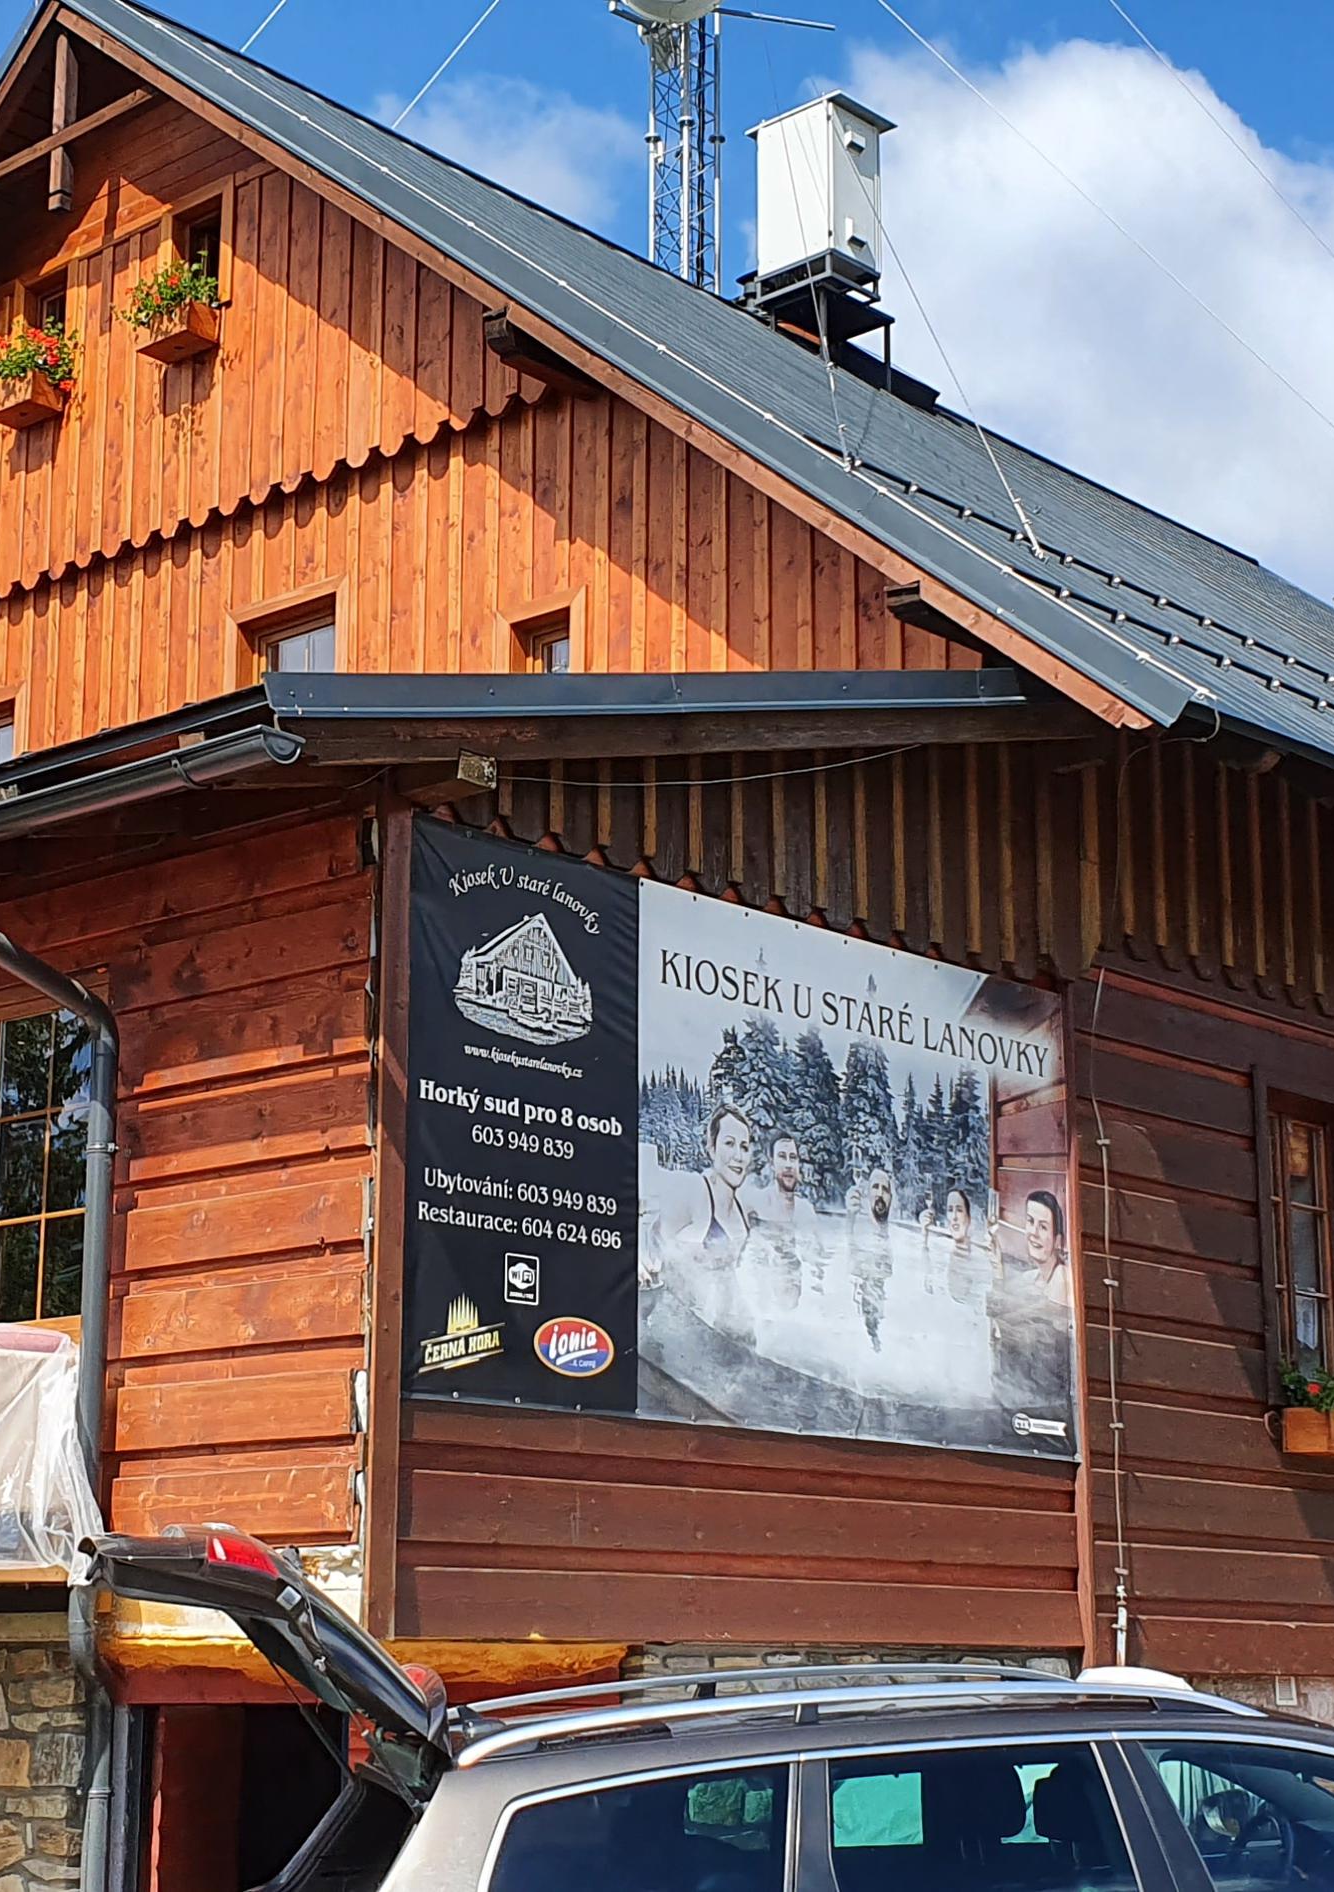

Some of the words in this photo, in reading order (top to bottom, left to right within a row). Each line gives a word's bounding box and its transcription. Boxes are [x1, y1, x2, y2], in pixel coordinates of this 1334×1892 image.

[500, 865, 514, 885] U
[517, 875, 550, 896] staré
[552, 883, 601, 935] lanovky
[659, 949, 783, 1013] KIOSEK
[793, 984, 814, 1020] U
[821, 991, 916, 1045] STARÉ
[923, 1016, 1050, 1078] LANOVKY
[419, 1079, 480, 1114] Horký
[483, 1097, 519, 1117] sud
[524, 1103, 557, 1125] pro
[561, 1108, 573, 1127] 8
[577, 1114, 623, 1137] osob
[471, 1124, 503, 1147] 603
[508, 1132, 539, 1153] 949
[543, 1139, 575, 1160] 839
[424, 1167, 513, 1200] Ubytování:
[517, 1183, 549, 1204] 603
[552, 1189, 584, 1210] 949
[586, 1195, 617, 1216] 839
[418, 1201, 518, 1235] Restaurace:
[522, 1216, 553, 1239] 604
[557, 1222, 588, 1244] 624
[591, 1228, 622, 1250] 696
[424, 1336, 466, 1365] ČERNÁ
[468, 1330, 500, 1354] HORA
